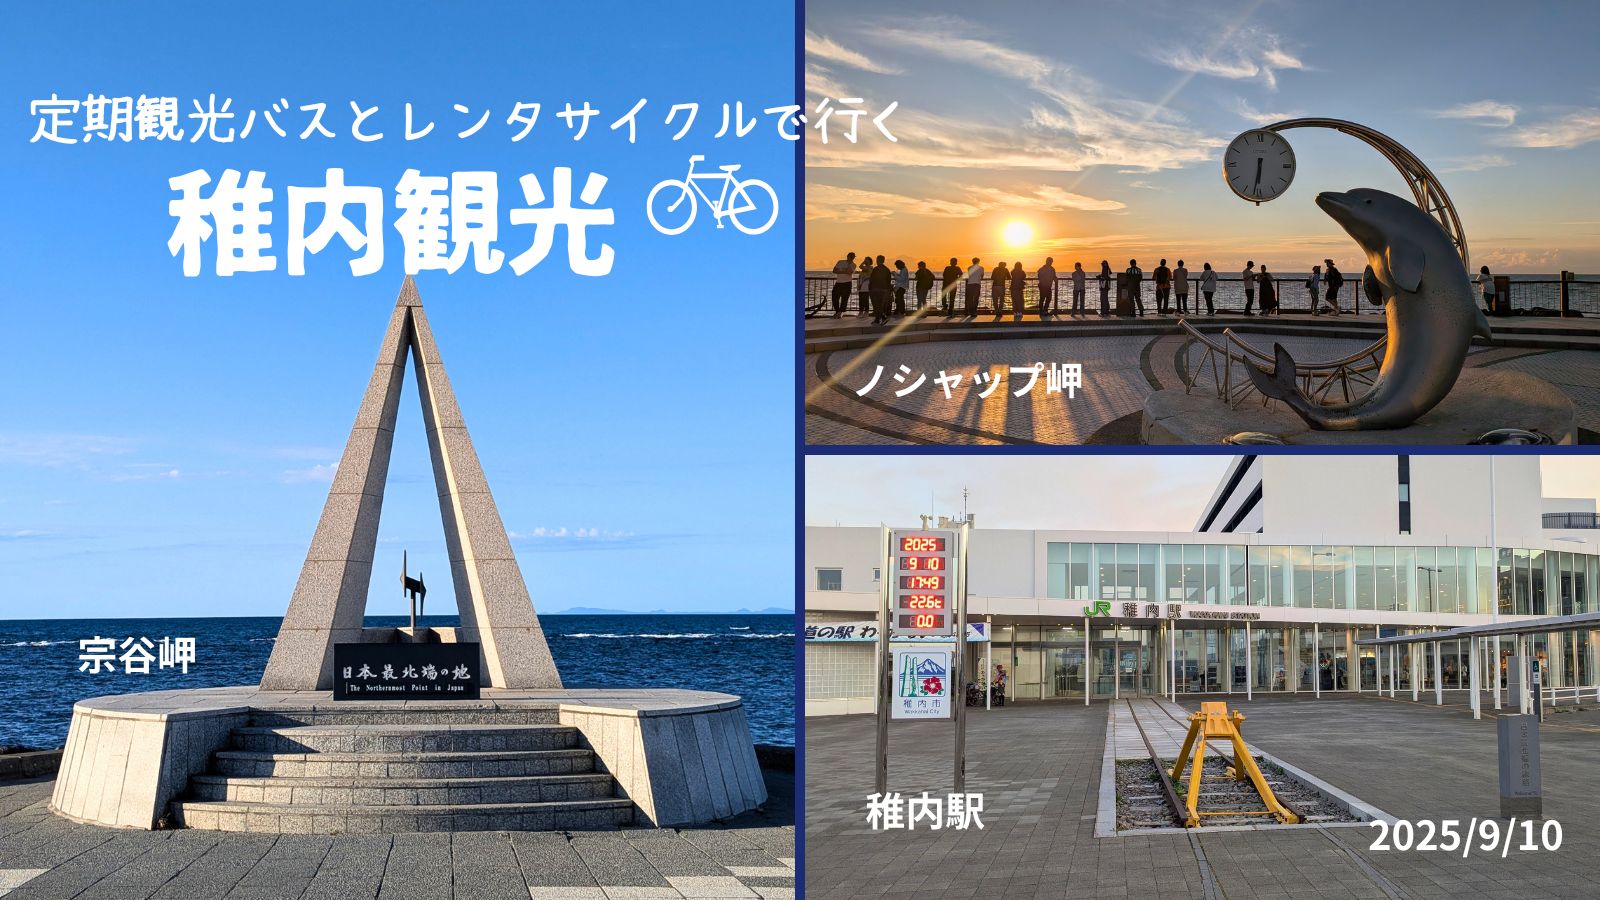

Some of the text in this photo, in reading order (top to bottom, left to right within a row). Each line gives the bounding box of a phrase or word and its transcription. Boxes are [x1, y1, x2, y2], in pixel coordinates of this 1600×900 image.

[904, 538, 937, 551] 2025
[909, 557, 939, 570] 9 10
[1083, 600, 1112, 617] JR
[1122, 602, 1182, 619] 稚内駅
[342, 663, 471, 681] 日本最北端の地
[349, 684, 361, 692] The
[366, 684, 406, 692] Northernmost
[447, 684, 464, 692] Japan
[903, 698, 941, 708] 稚内市
